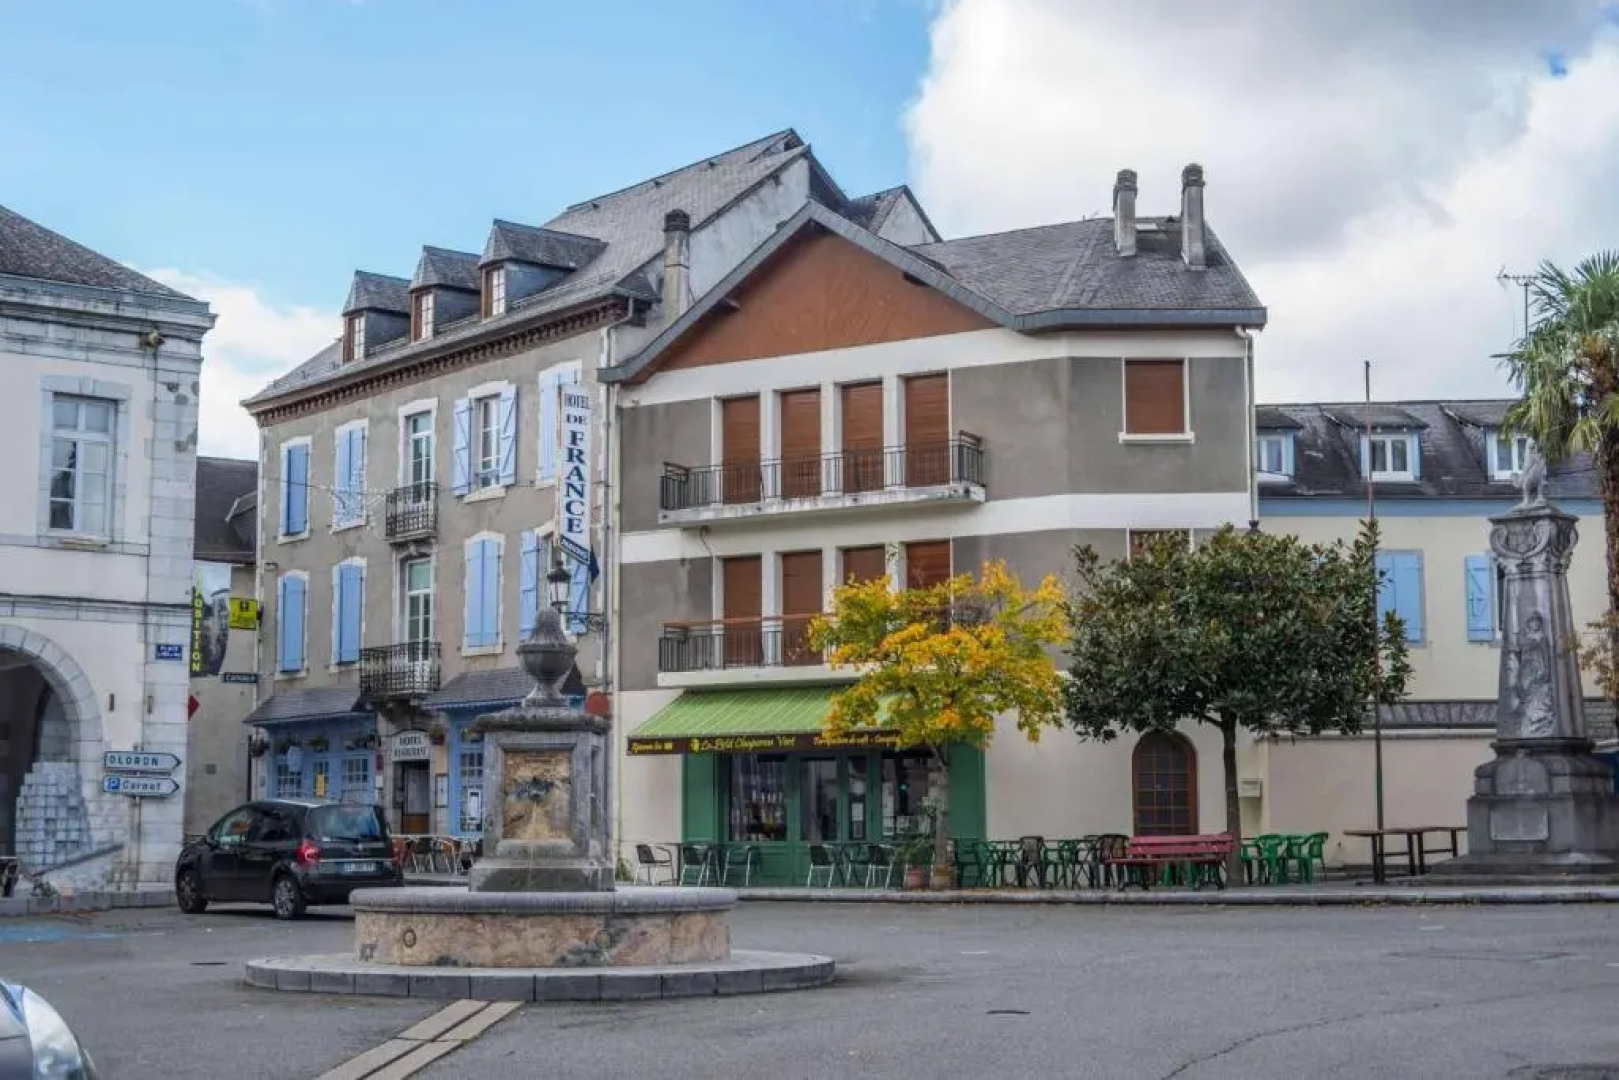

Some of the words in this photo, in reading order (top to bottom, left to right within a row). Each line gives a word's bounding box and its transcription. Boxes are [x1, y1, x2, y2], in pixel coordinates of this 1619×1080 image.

[566, 414, 588, 424] DE
[565, 429, 586, 533] FRANCE
[109, 755, 158, 766] OLORON
